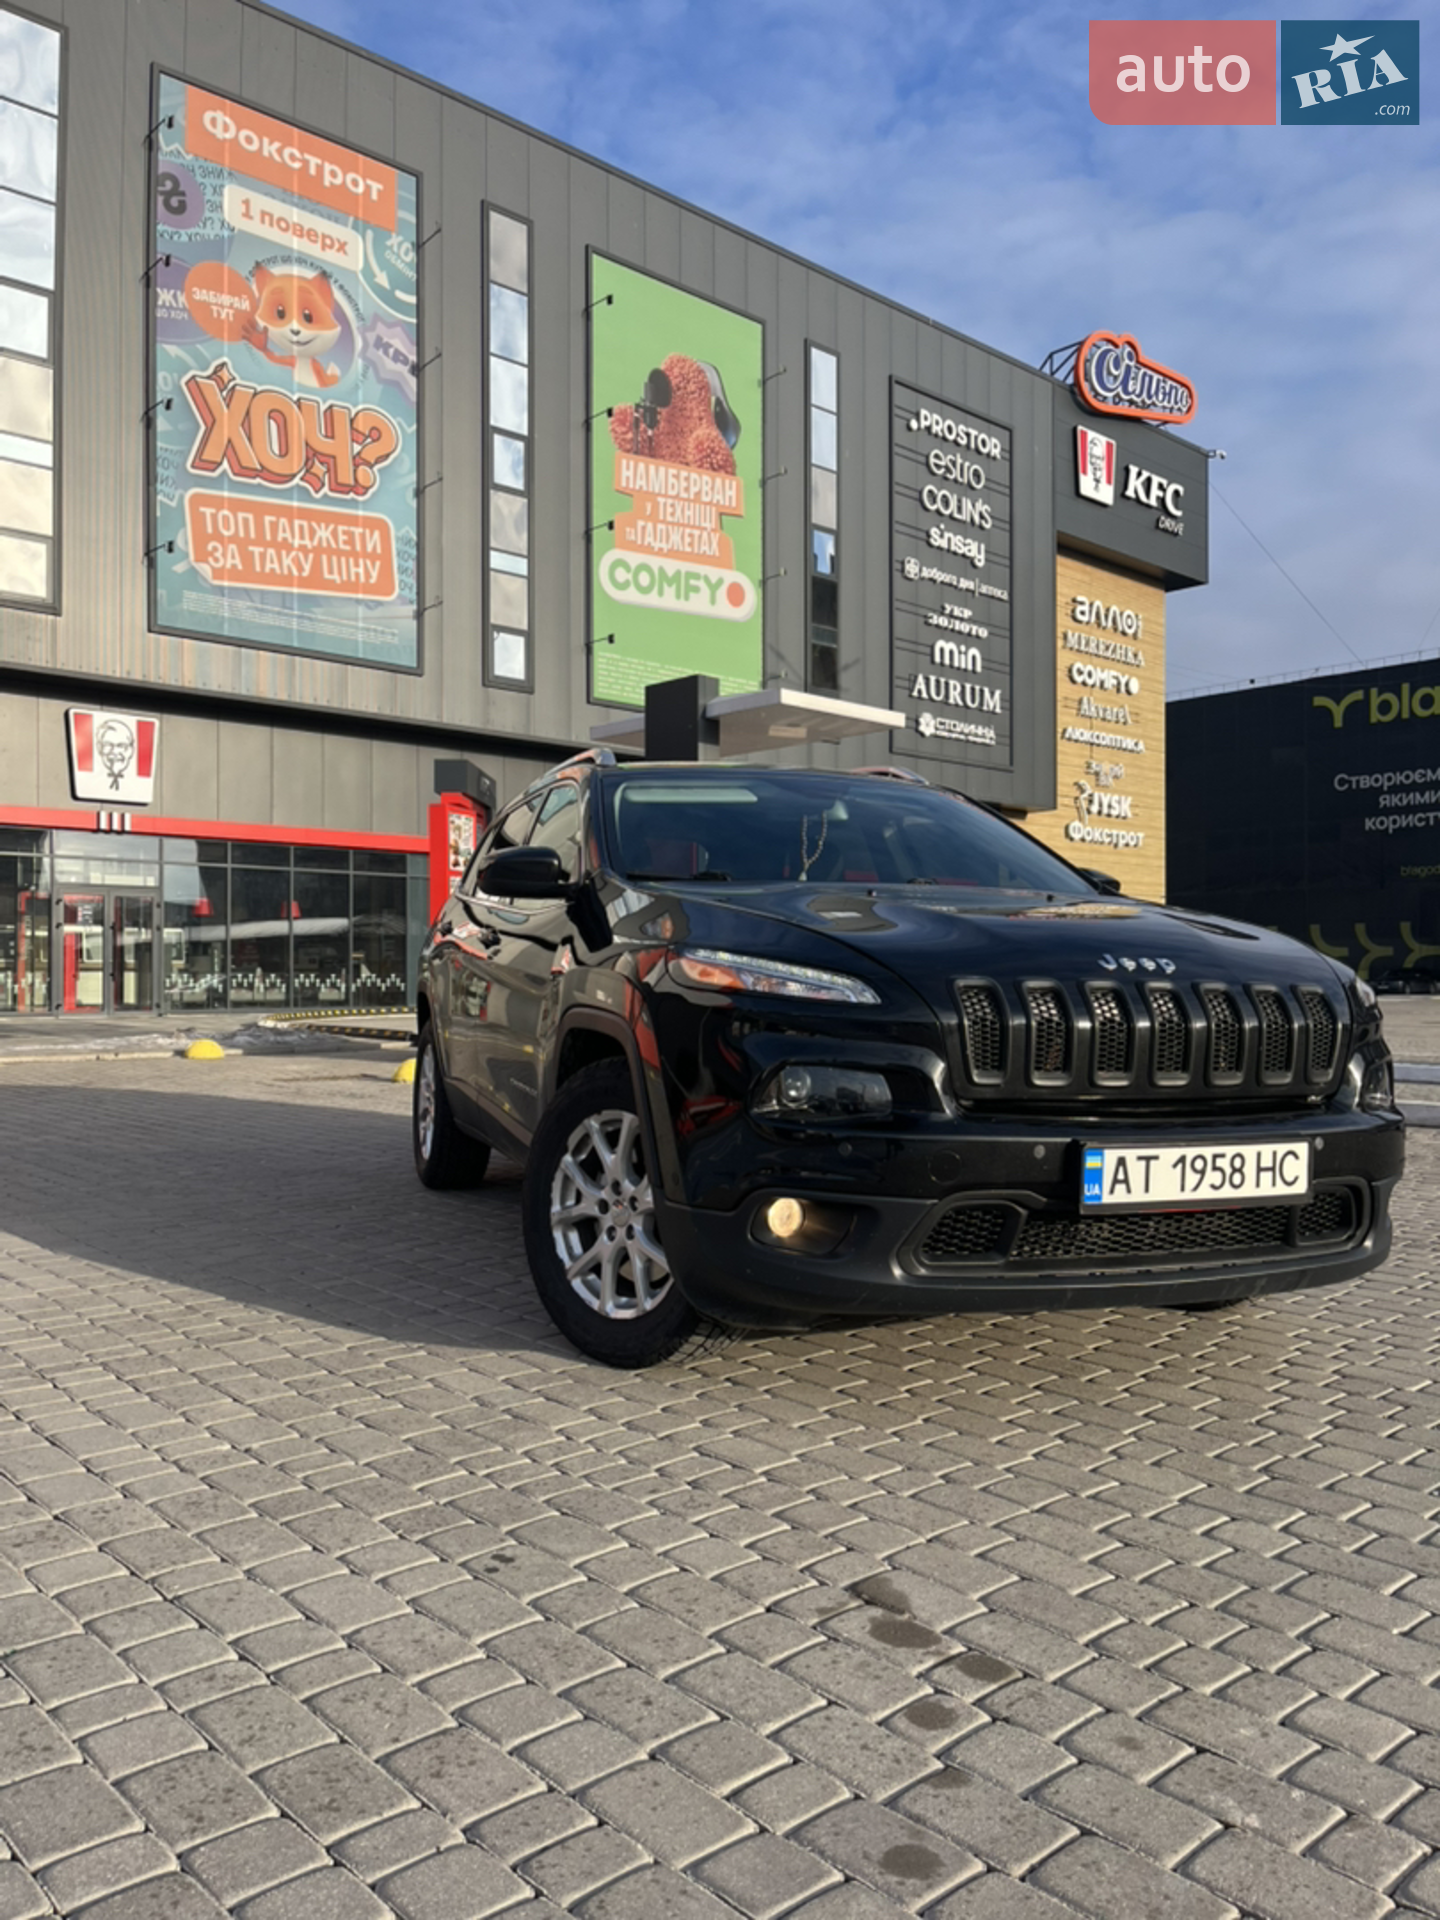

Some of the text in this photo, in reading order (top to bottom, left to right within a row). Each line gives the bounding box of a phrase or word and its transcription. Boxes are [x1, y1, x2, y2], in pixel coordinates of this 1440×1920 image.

[203, 109, 383, 202] Фокстрот
[240, 197, 350, 257] 1 поверх
[192, 287, 250, 311] ЗАБИРАЙ
[210, 305, 235, 321] ТУТ
[184, 371, 400, 499] ХОЧ?
[620, 458, 737, 508] НАМБЕРВАН
[929, 449, 985, 489] estro
[923, 485, 992, 529] COLIN'S
[1125, 464, 1184, 517] KFC
[199, 507, 381, 554] ТОП ГАДЖЕТИ
[656, 497, 716, 530] ТЕХНІЦІ
[635, 520, 720, 557] ГАДЖЕТАХ
[930, 523, 986, 568] sinsay
[207, 541, 242, 570] ЗА
[248, 546, 313, 577] ТАКУ
[321, 555, 381, 585] ЦІНУ
[608, 557, 724, 606] COMFY
[933, 639, 982, 673] min
[1071, 661, 1129, 693] COMFY
[912, 673, 1002, 714] AURUM
[1068, 820, 1145, 848] Фокстрот
[1364, 812, 1440, 834] корист
[1098, 953, 1176, 974] Jeep
[1084, 1150, 1300, 1196] UA AT 1958 HC
